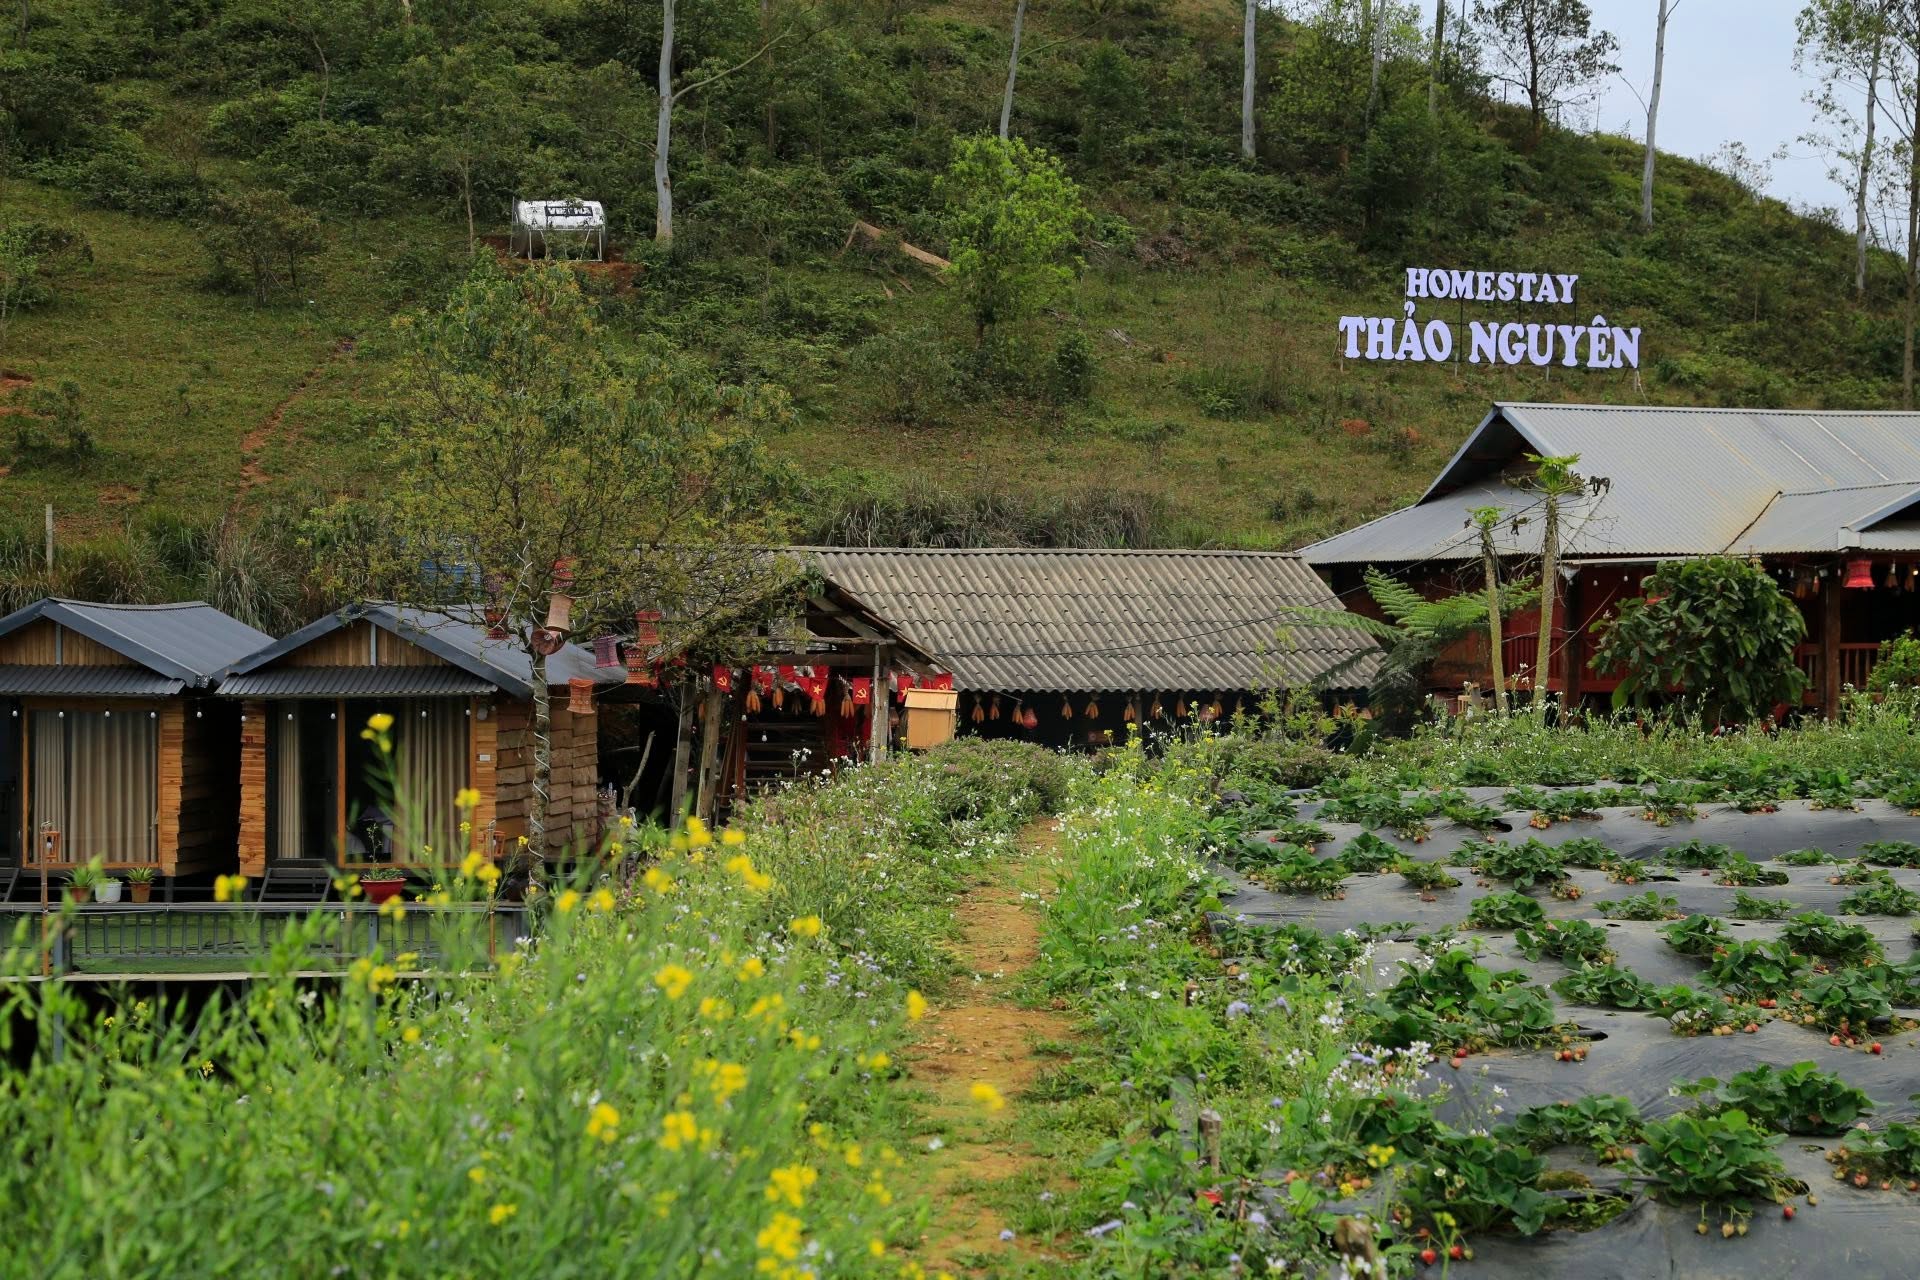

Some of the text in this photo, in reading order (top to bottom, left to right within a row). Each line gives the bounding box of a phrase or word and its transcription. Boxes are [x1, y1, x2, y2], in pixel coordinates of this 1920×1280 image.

[1406, 267, 1579, 304] HOMESTAY
[1338, 301, 1642, 369] THẢO NGUYÊN
